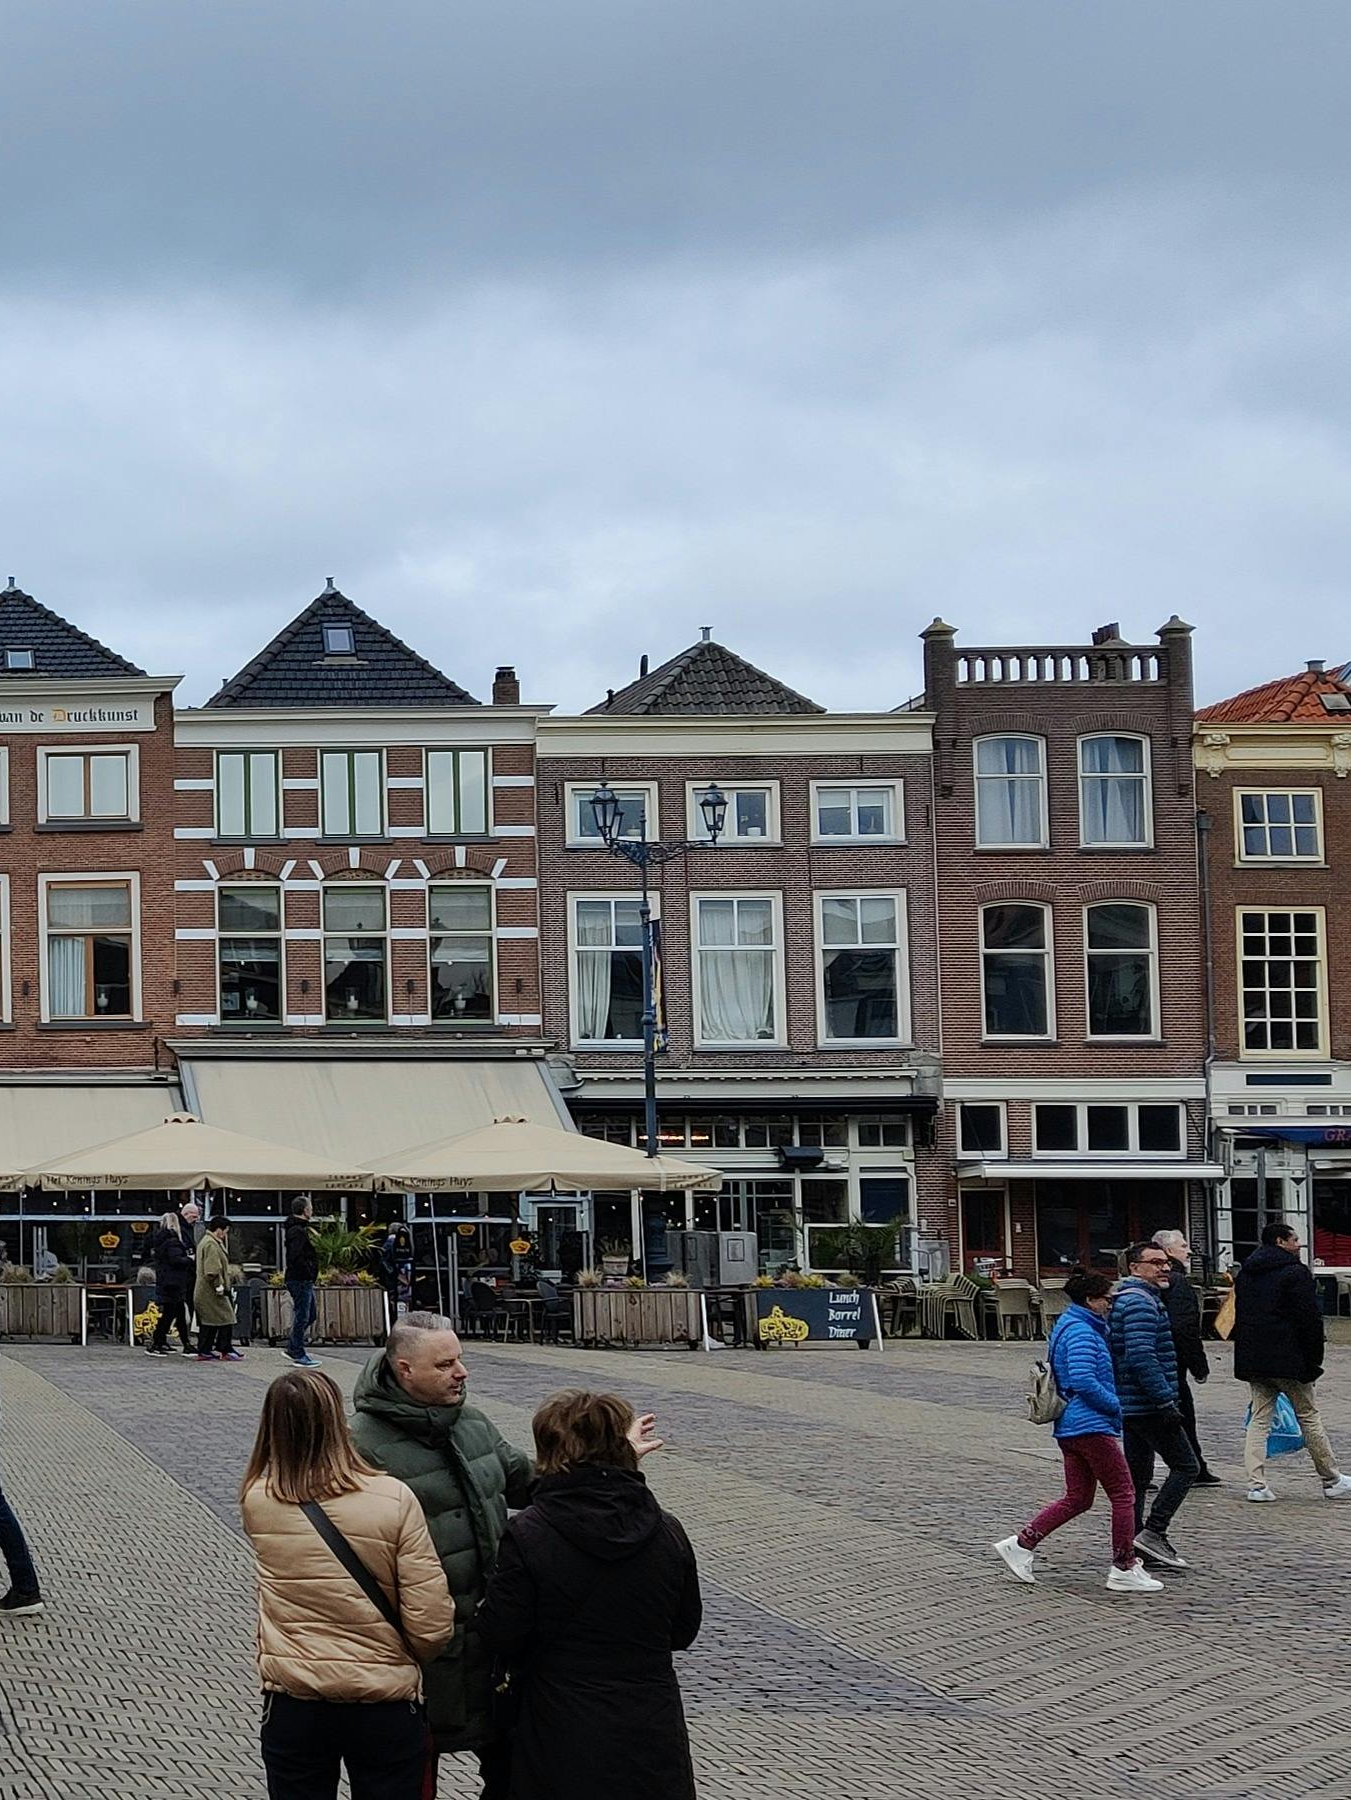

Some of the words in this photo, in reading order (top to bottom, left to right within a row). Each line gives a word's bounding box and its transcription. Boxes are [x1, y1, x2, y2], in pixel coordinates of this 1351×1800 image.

[29, 710, 44, 722] de
[52, 708, 138, 723] Druckkunst
[1324, 1128, 1351, 1141] GR
[104, 1174, 129, 1186] Huys
[449, 1177, 474, 1189] Huys
[829, 1289, 860, 1304] Lunch
[827, 1306, 861, 1321] Borrel
[828, 1325, 857, 1339] Diner
